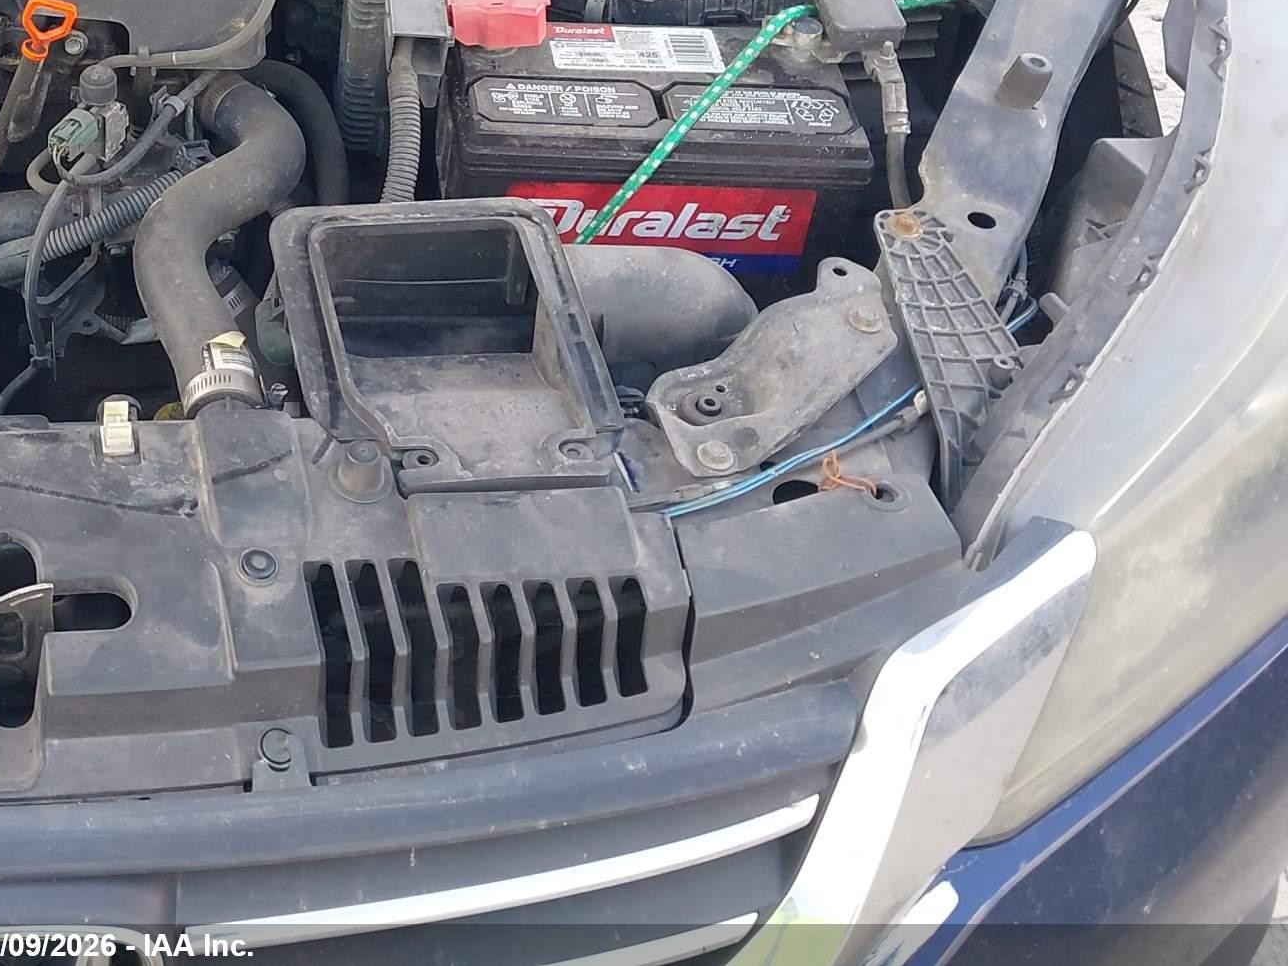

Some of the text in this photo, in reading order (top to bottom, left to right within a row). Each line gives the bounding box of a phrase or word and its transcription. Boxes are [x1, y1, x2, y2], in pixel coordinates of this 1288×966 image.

[552, 26, 606, 35] Duralast
[517, 84, 563, 92] DANGER
[574, 85, 616, 94] POISON
